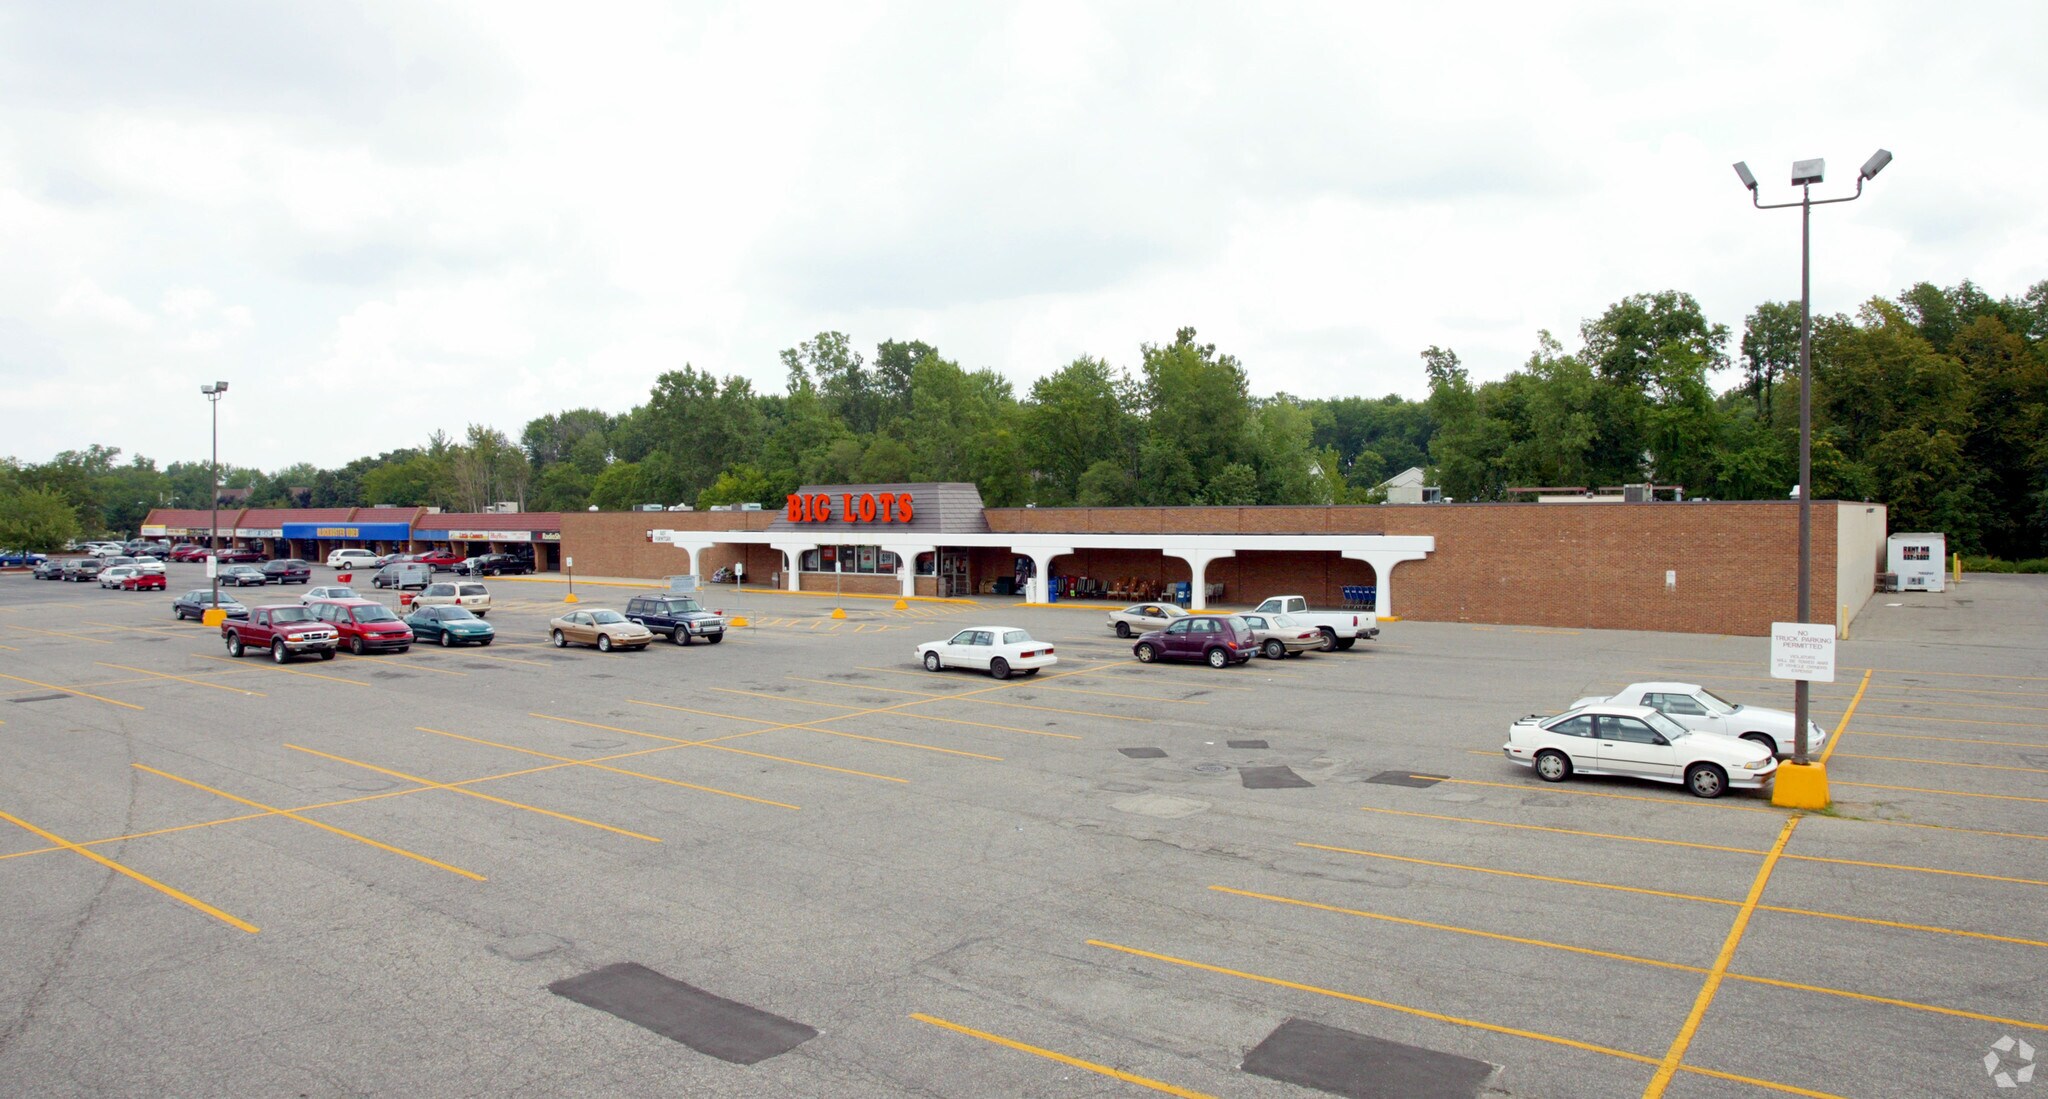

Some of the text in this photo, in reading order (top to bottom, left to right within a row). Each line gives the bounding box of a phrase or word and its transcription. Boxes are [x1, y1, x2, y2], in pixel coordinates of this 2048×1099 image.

[787, 493, 914, 523] BIG LOTS
[1801, 636, 1832, 644] PARKING
[1782, 642, 1823, 650] PERMITTED
